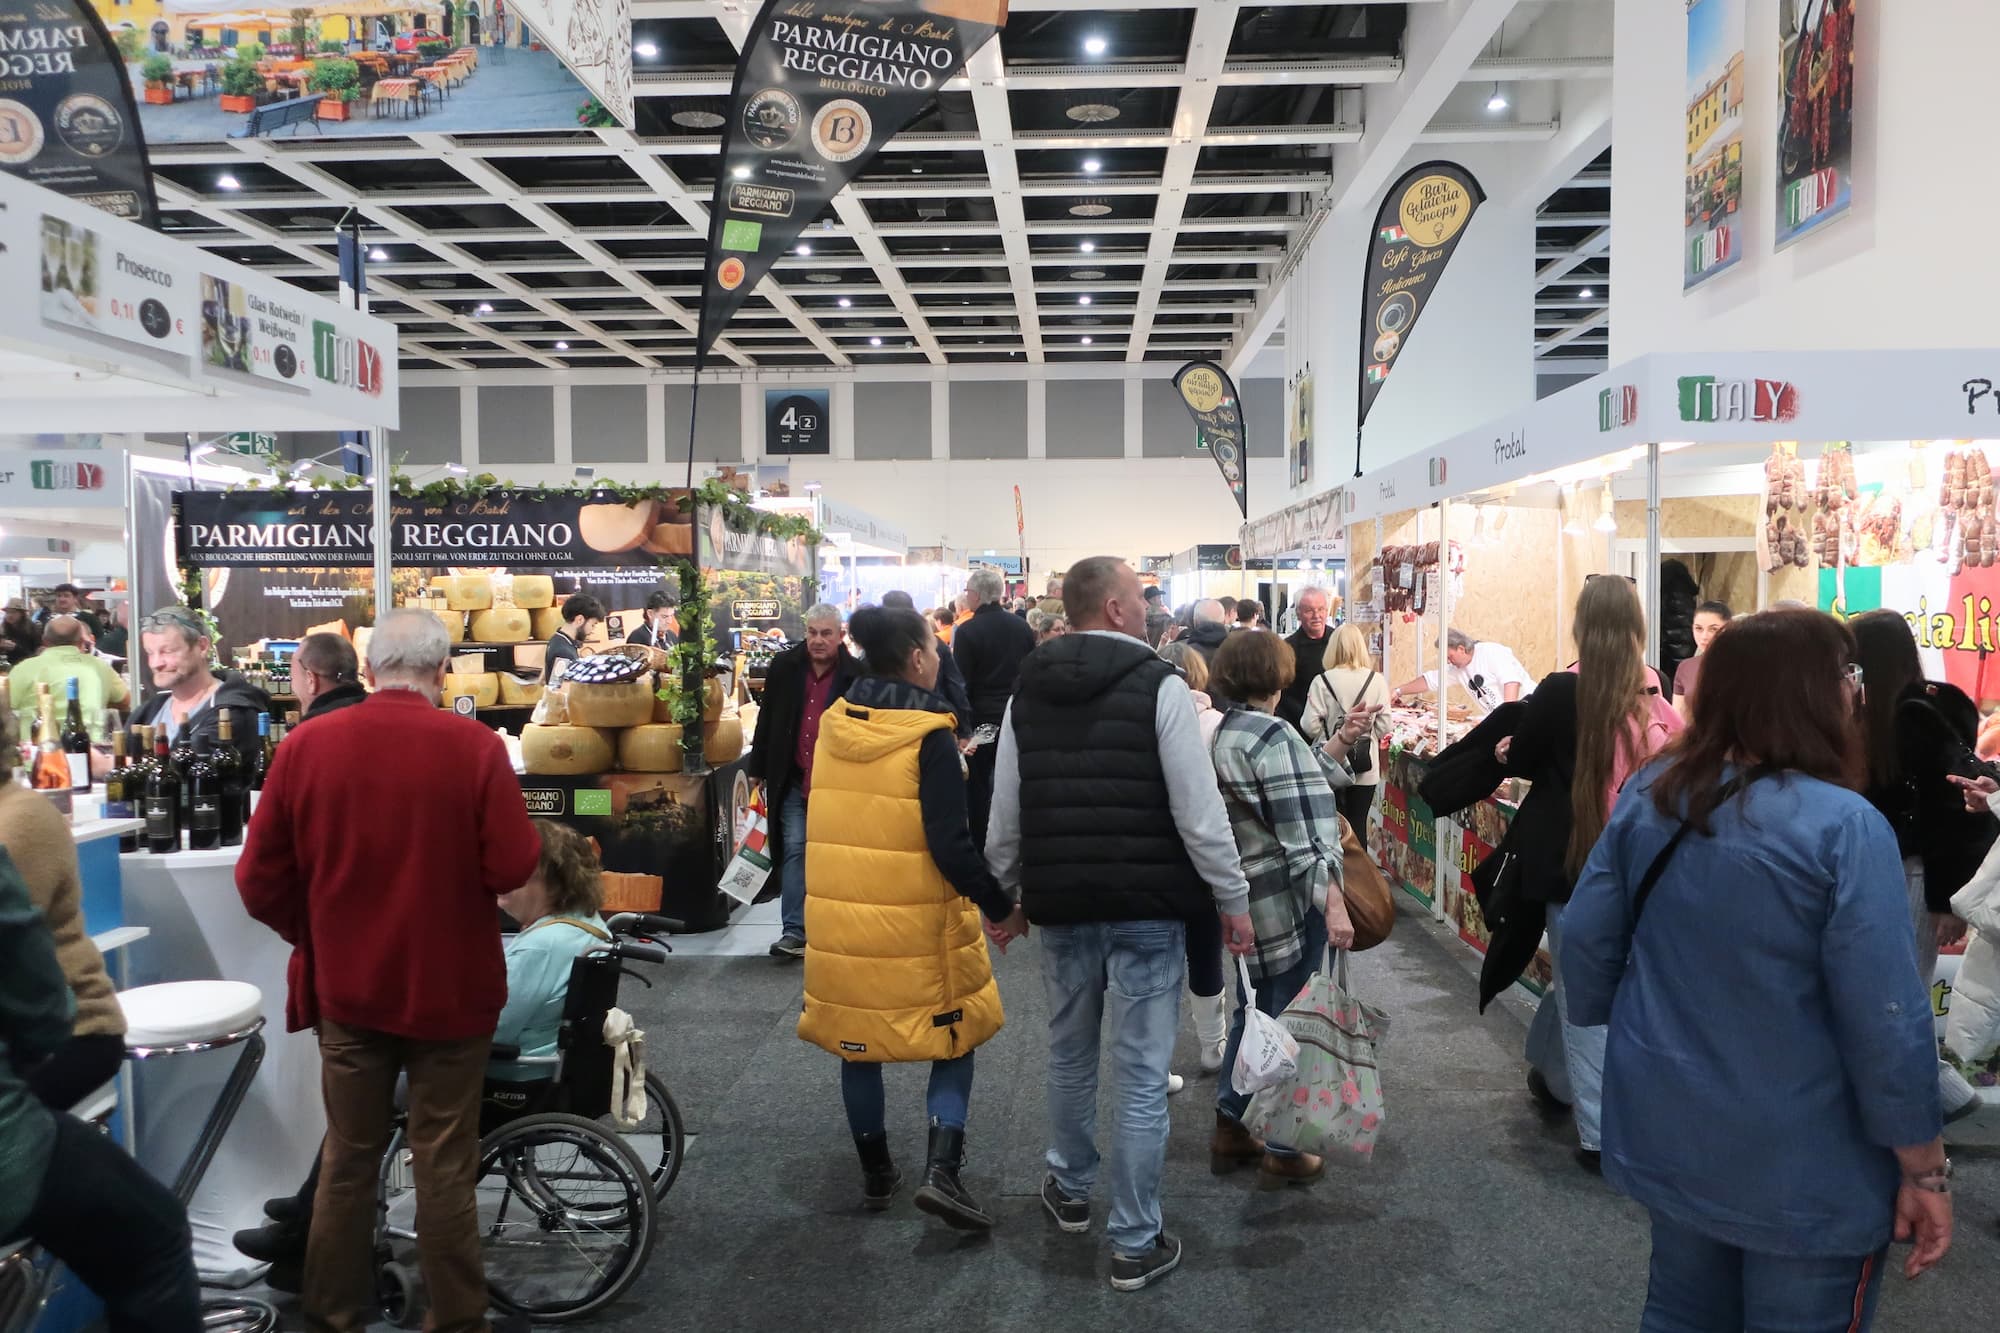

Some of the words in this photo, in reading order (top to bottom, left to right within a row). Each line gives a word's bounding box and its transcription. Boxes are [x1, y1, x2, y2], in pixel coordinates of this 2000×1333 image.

[771, 21, 953, 69] PARMIGIANO
[782, 48, 932, 90] REGGIANO
[819, 77, 888, 97] BIOLOGICO
[830, 116, 856, 143] B
[735, 186, 790, 201] PARMIGIANO
[739, 196, 782, 211] REGGIANO
[1420, 182, 1449, 201] Bar
[1792, 167, 1832, 225] ITALY
[117, 252, 172, 288] Prosecco
[248, 294, 267, 312] Glas
[269, 301, 301, 326] Rotwein
[259, 318, 296, 343] Weißwein
[323, 330, 376, 392] ITALY
[1603, 385, 1635, 430] ITALY
[1694, 382, 1789, 421] ITALY
[780, 407, 798, 430] 4
[804, 418, 811, 428] 2
[40, 462, 96, 490] ITALY
[402, 523, 573, 548] REGGIANO
[205, 552, 255, 561] BIOLOGISCHE
[255, 552, 309, 561] HERSTELLUNG
[310, 552, 327, 561] VON
[327, 552, 344, 561] DER
[345, 552, 373, 561] FAMILIE
[415, 551, 430, 561] SEIT
[450, 551, 467, 560] VON
[468, 551, 488, 560] ERDE
[489, 551, 500, 560] ZU
[501, 551, 524, 560] TISCH
[525, 551, 549, 560] OHNE
[549, 551, 574, 561] O.G.M.
[521, 791, 560, 801] MIGIANO
